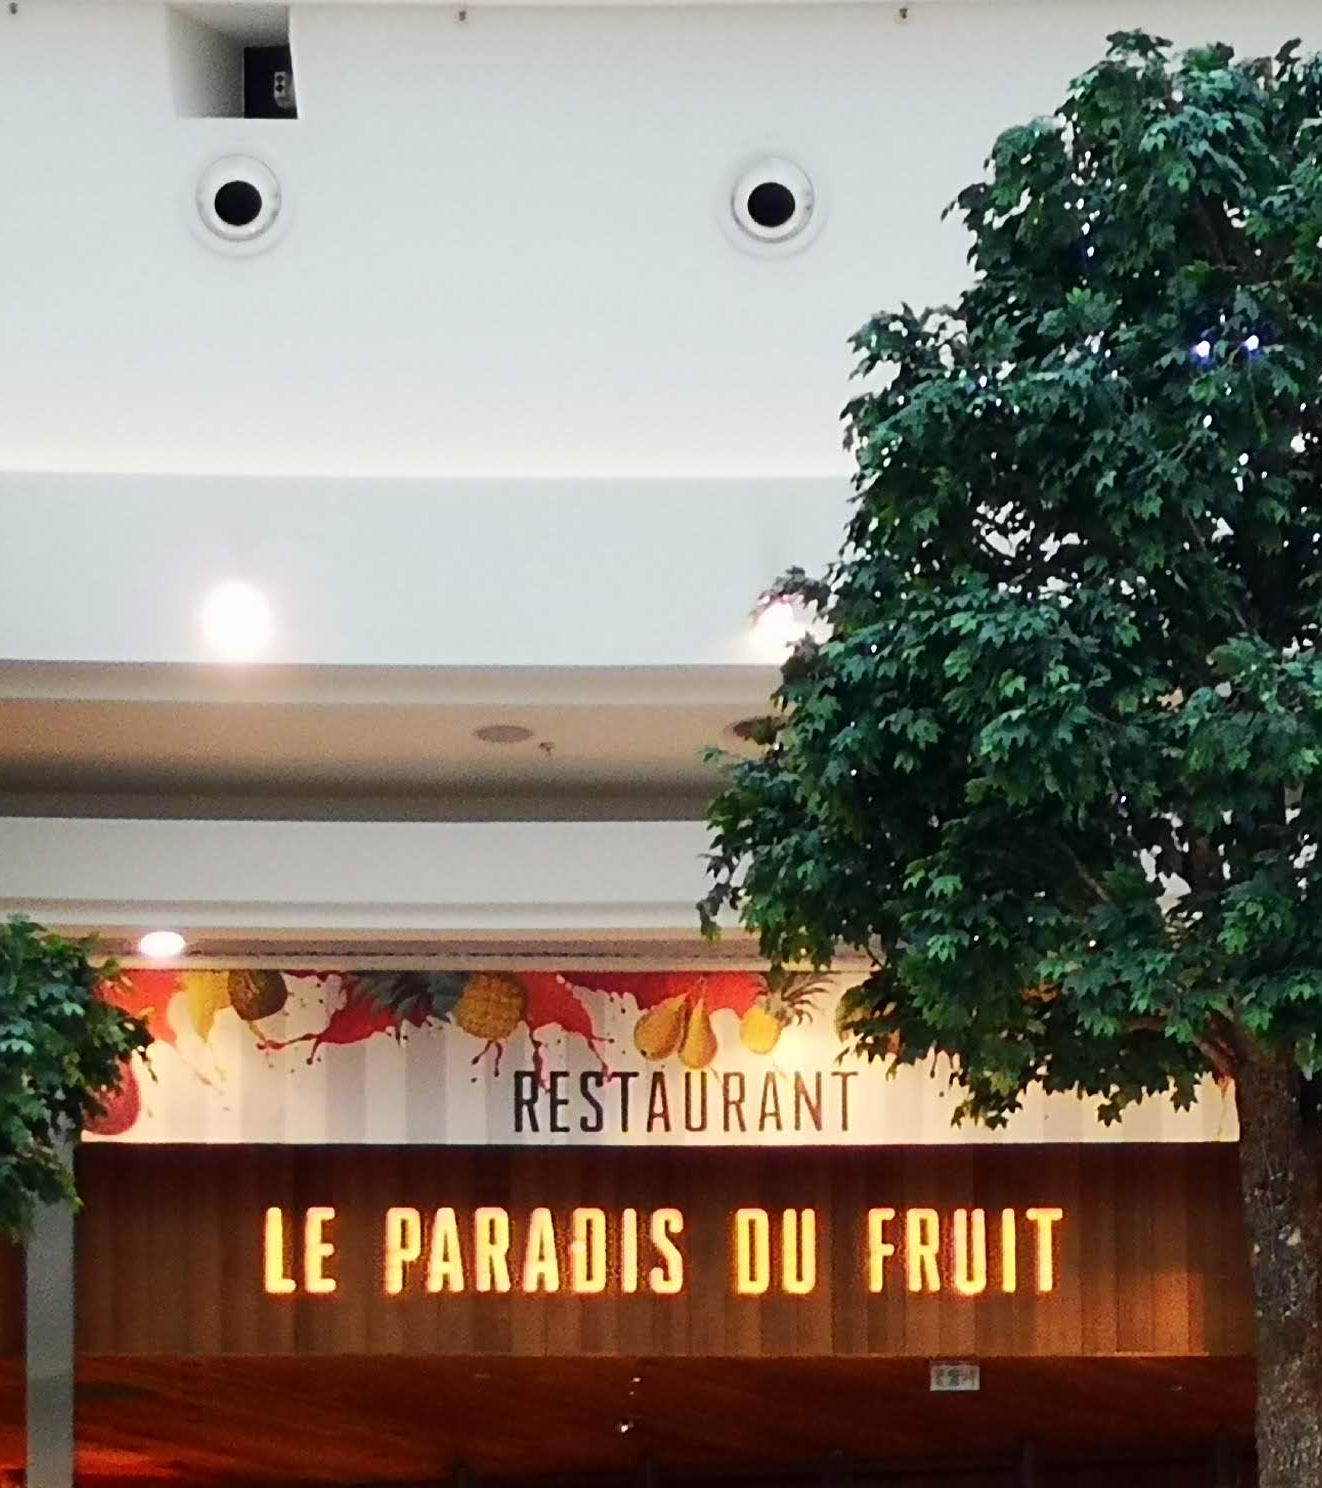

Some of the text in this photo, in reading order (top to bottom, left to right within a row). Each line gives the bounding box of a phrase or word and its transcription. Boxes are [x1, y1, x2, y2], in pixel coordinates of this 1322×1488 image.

[513, 1070, 858, 1133] RESTAURANT
[265, 1207, 1062, 1295] LE PARADIS DU FRUIT
